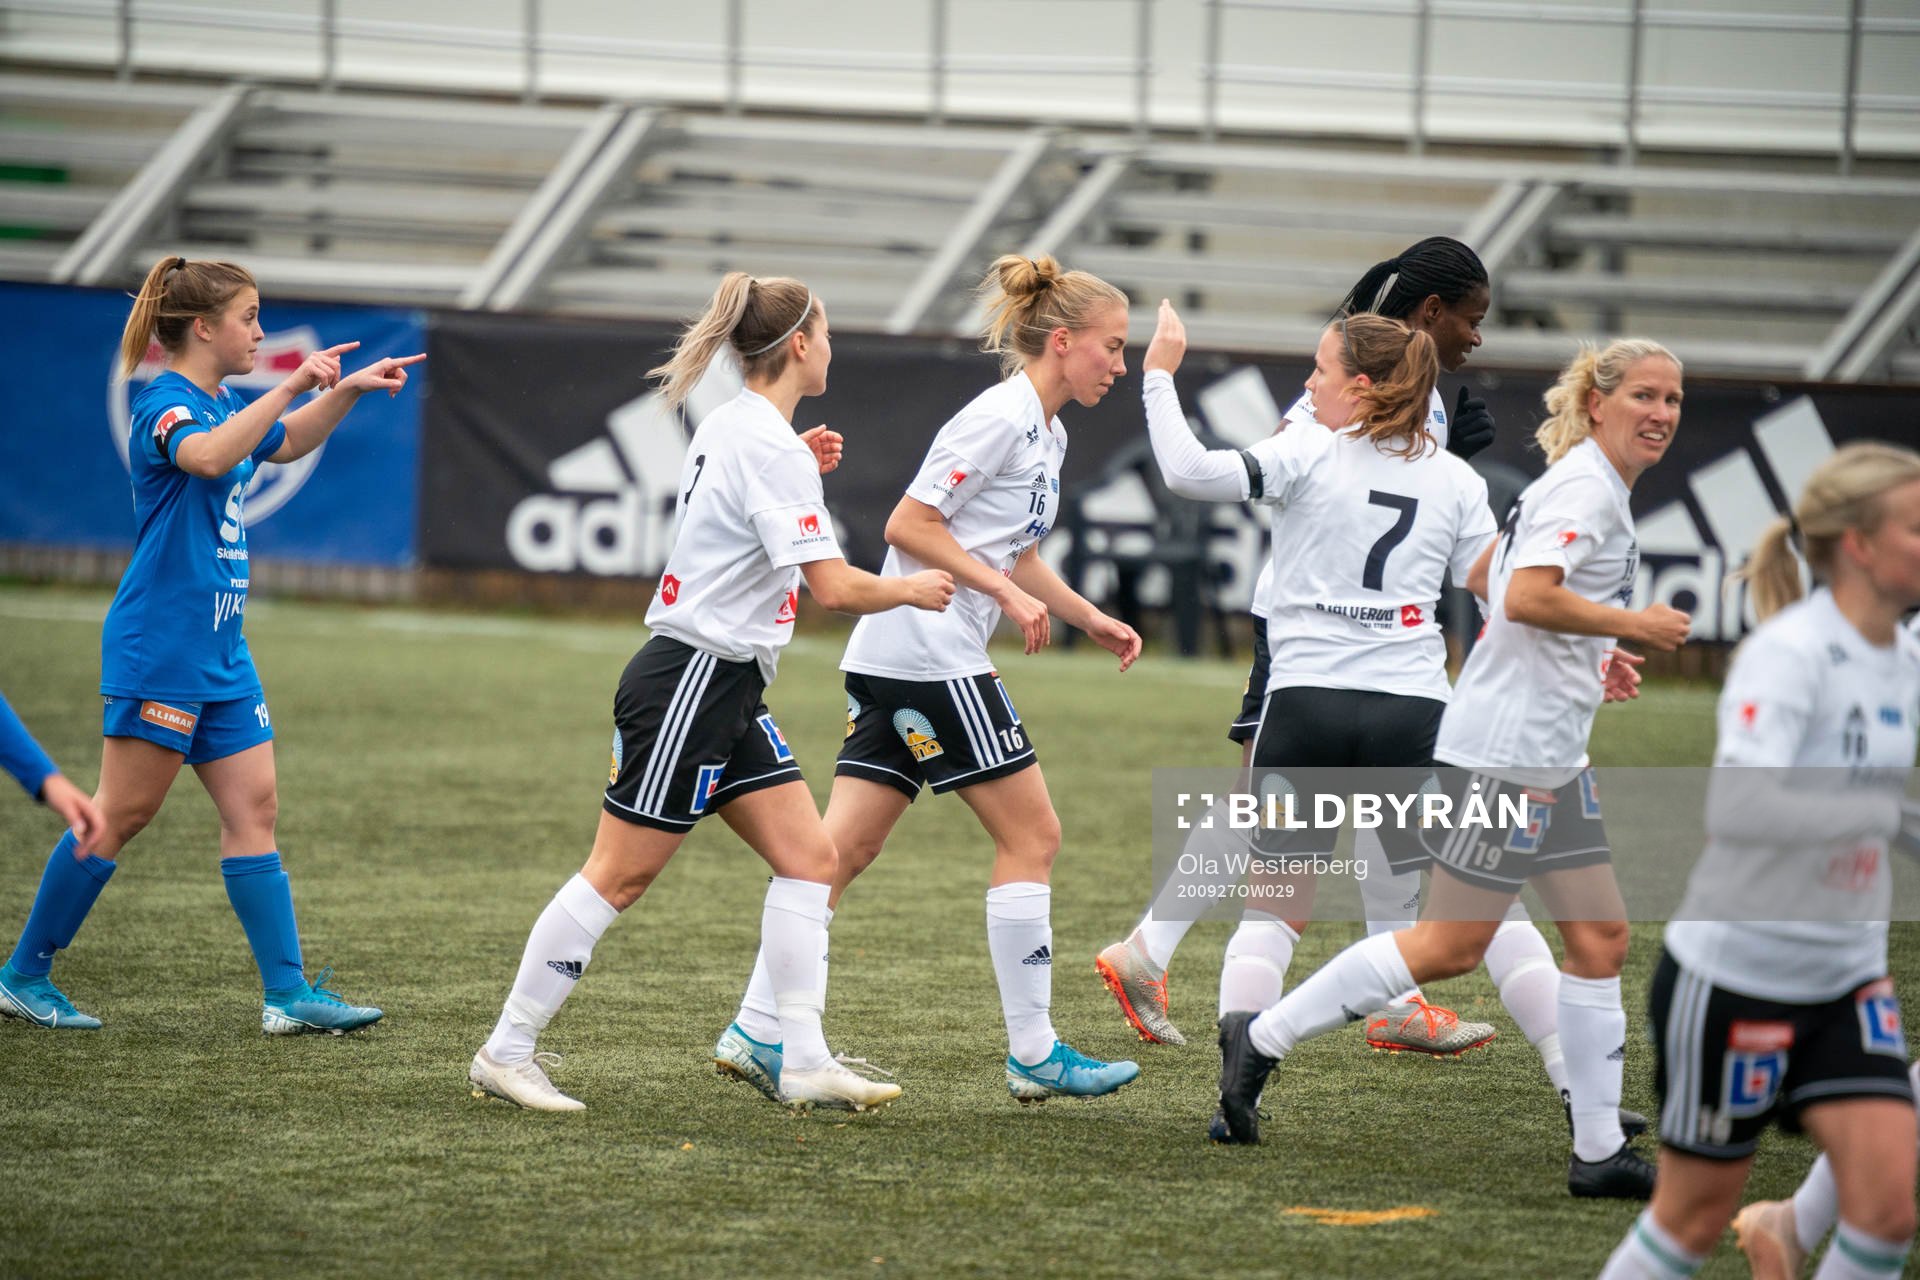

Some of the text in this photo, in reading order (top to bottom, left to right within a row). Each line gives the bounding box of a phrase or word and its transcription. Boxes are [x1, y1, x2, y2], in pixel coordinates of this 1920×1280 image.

[1029, 492, 1046, 516] 16
[1363, 490, 1419, 592] 7
[146, 707, 193, 729] ALIMAK
[254, 703, 269, 728] 19
[999, 726, 1024, 753] 16
[1474, 840, 1503, 871] 19
